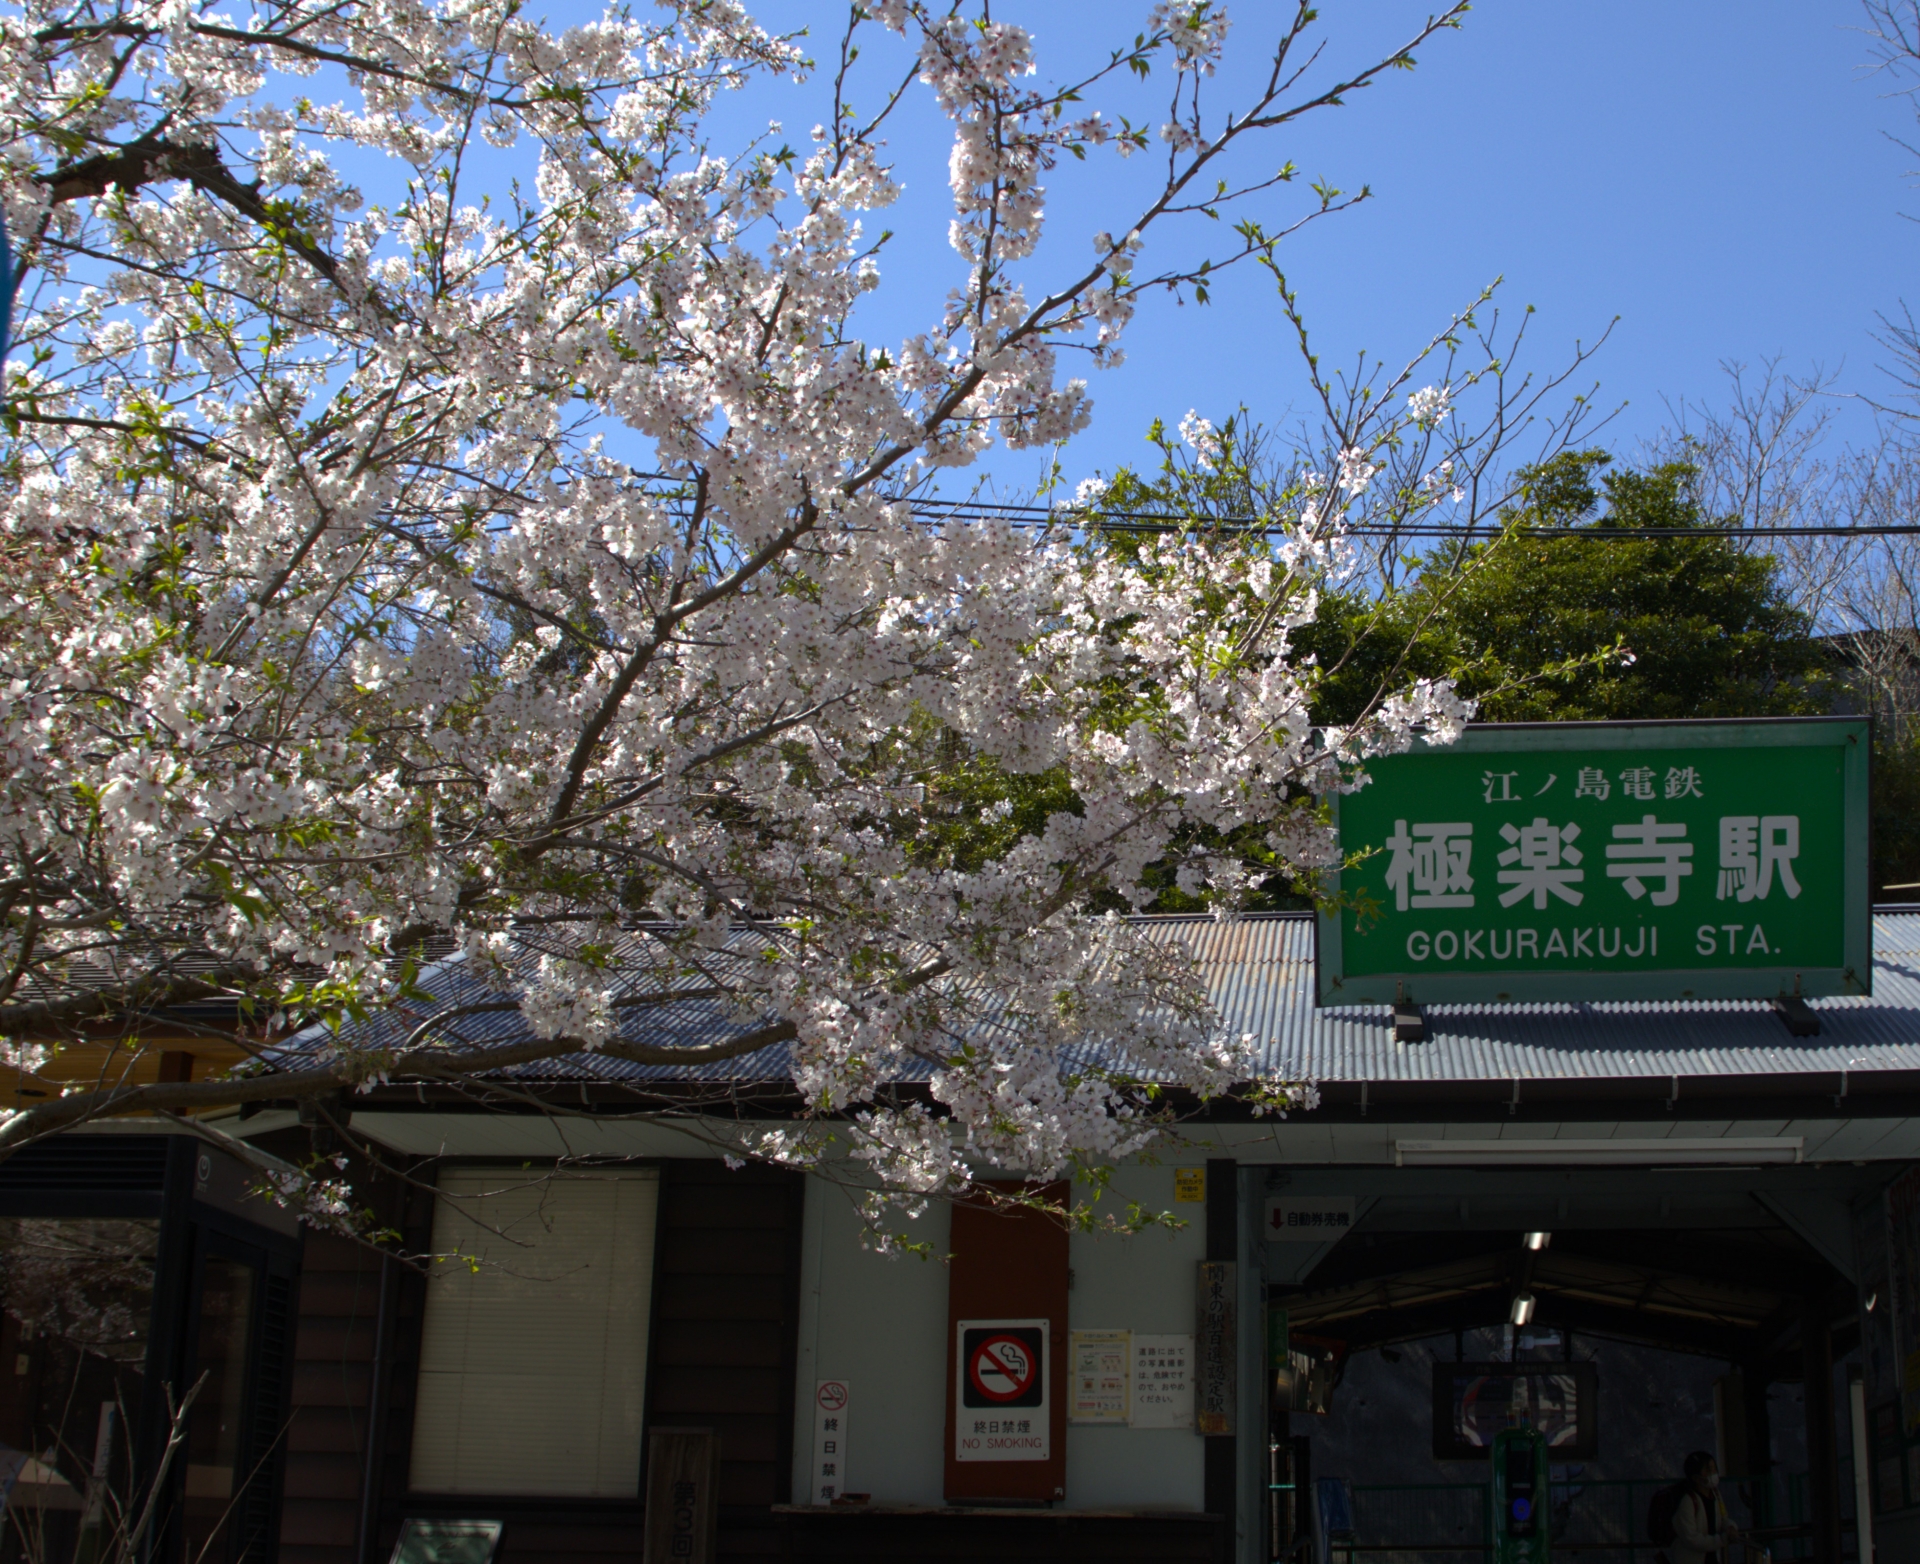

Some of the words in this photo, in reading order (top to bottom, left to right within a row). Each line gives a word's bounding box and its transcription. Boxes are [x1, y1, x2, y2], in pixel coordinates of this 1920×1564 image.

[1480, 765, 1705, 804] 江ノ島電鉄
[1384, 814, 1803, 912] 極楽寺駅
[1405, 925, 1658, 962] GOKURAKUJI
[1696, 924, 1782, 957] STA.
[1287, 1212, 1350, 1227] 自動券売機
[1206, 1264, 1226, 1412] 関東の駅百選認定駅
[1138, 1347, 1185, 1356] 道路に出て
[1138, 1359, 1185, 1367] の写真撮影
[1138, 1371, 1185, 1380] は、危険です
[1138, 1383, 1185, 1391] ので、おやめ
[1139, 1395, 1173, 1403] ください。
[973, 1420, 1031, 1434] 終日禁煙
[962, 1438, 981, 1449] NO
[986, 1437, 1042, 1449] SMOKING
[820, 1417, 839, 1500] 終日禁煙
